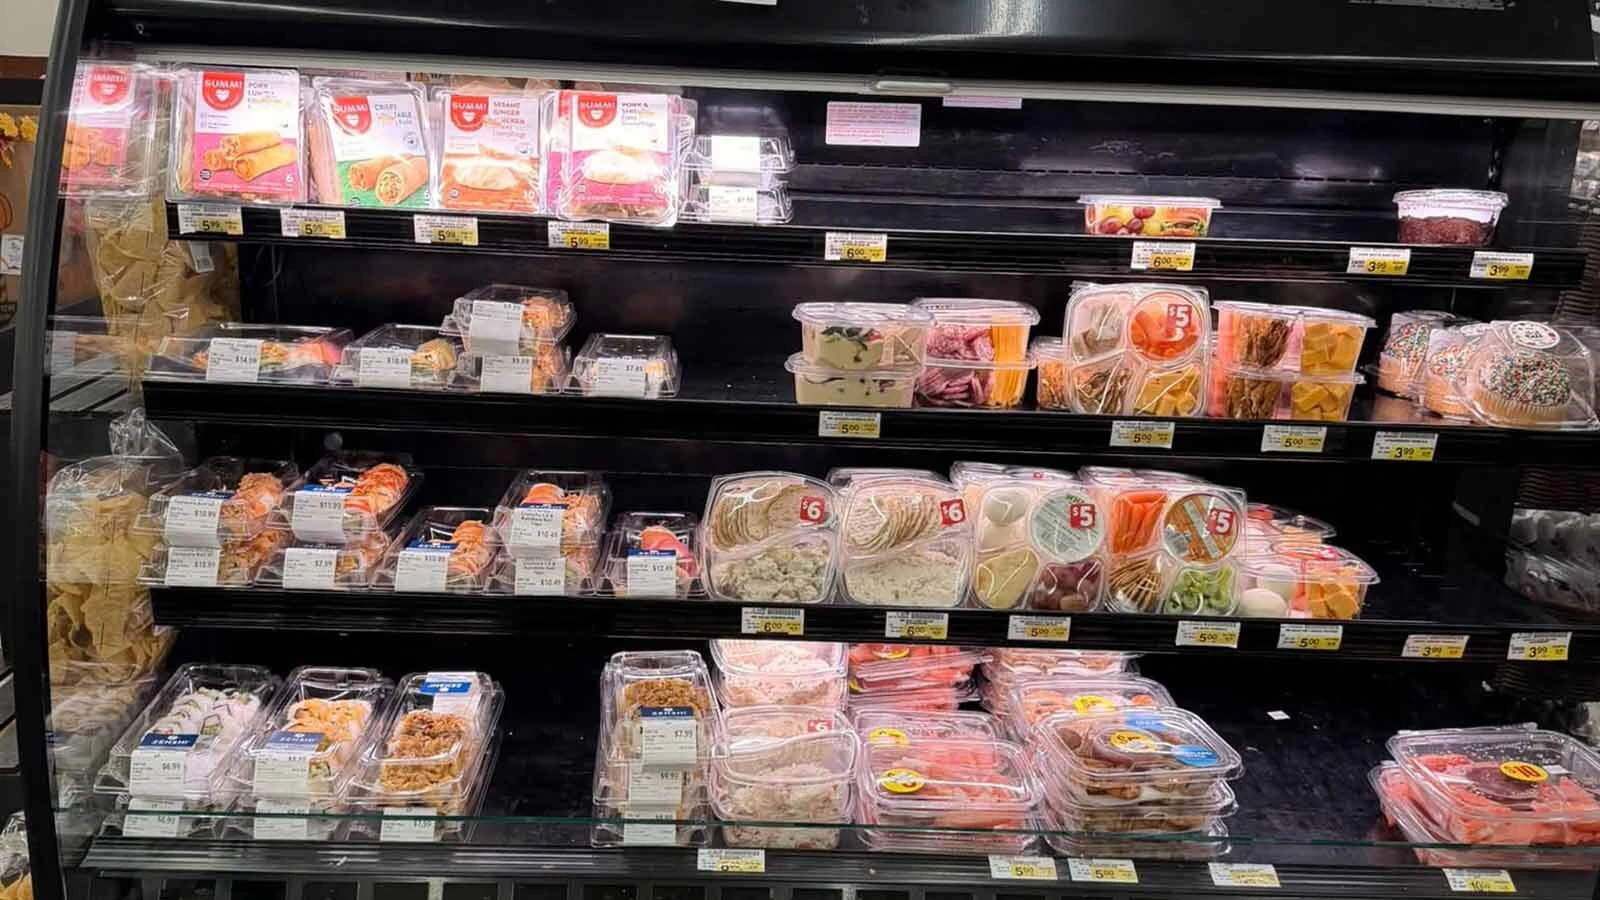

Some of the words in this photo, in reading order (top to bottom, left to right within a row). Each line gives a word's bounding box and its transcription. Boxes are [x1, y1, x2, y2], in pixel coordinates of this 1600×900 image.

[204, 79, 243, 89] SUMM!
[452, 101, 487, 110] SUMM!
[580, 101, 616, 110] SUMM!
[1169, 305, 1190, 328] $5
[802, 500, 821, 520] $6
[942, 502, 963, 522] $6
[1072, 505, 1093, 527] $5
[1211, 510, 1232, 533] $5
